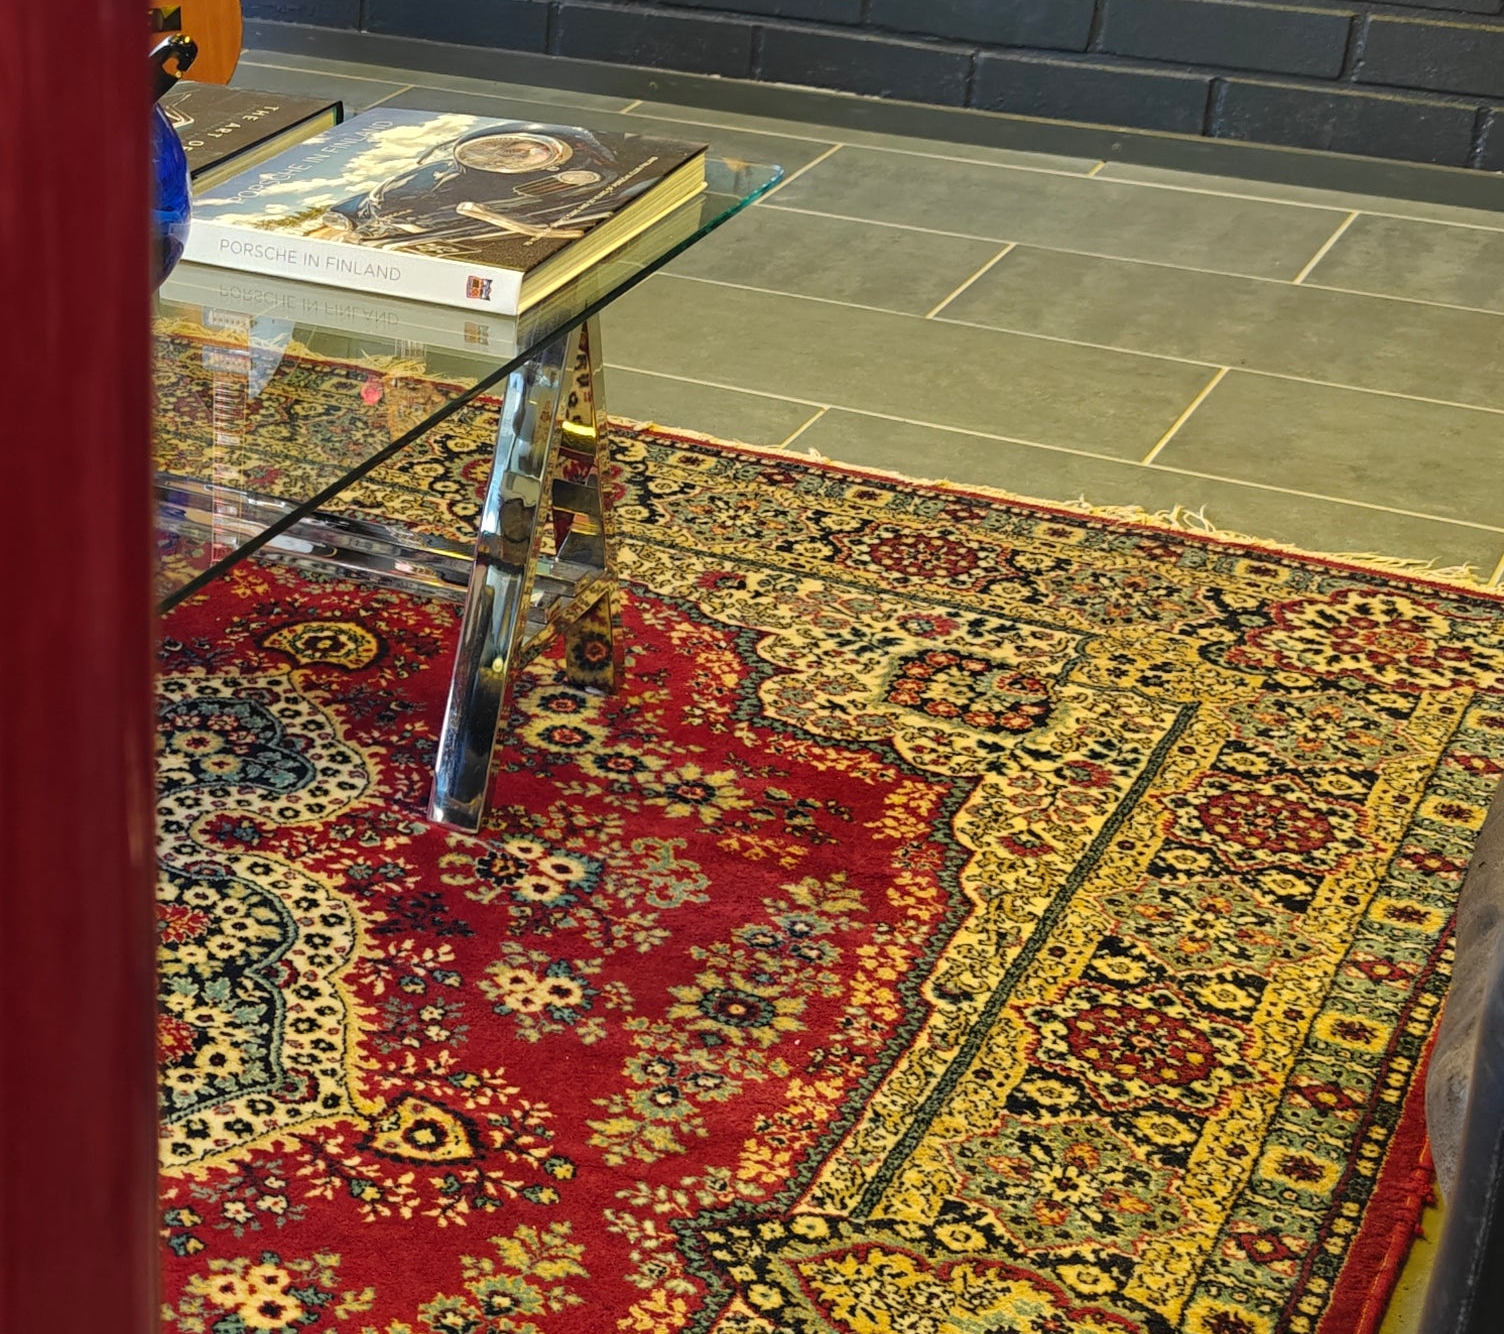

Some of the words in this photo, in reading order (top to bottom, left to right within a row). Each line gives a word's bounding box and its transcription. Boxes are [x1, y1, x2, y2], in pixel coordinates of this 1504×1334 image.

[242, 106, 279, 122] THE
[207, 122, 241, 138] ART
[229, 163, 312, 204] PORSCHE
[302, 153, 331, 164] IN
[321, 120, 394, 154] FINLAND
[220, 238, 298, 265] PORSCHE
[303, 252, 320, 268] IN
[325, 256, 402, 282] FINLAND
